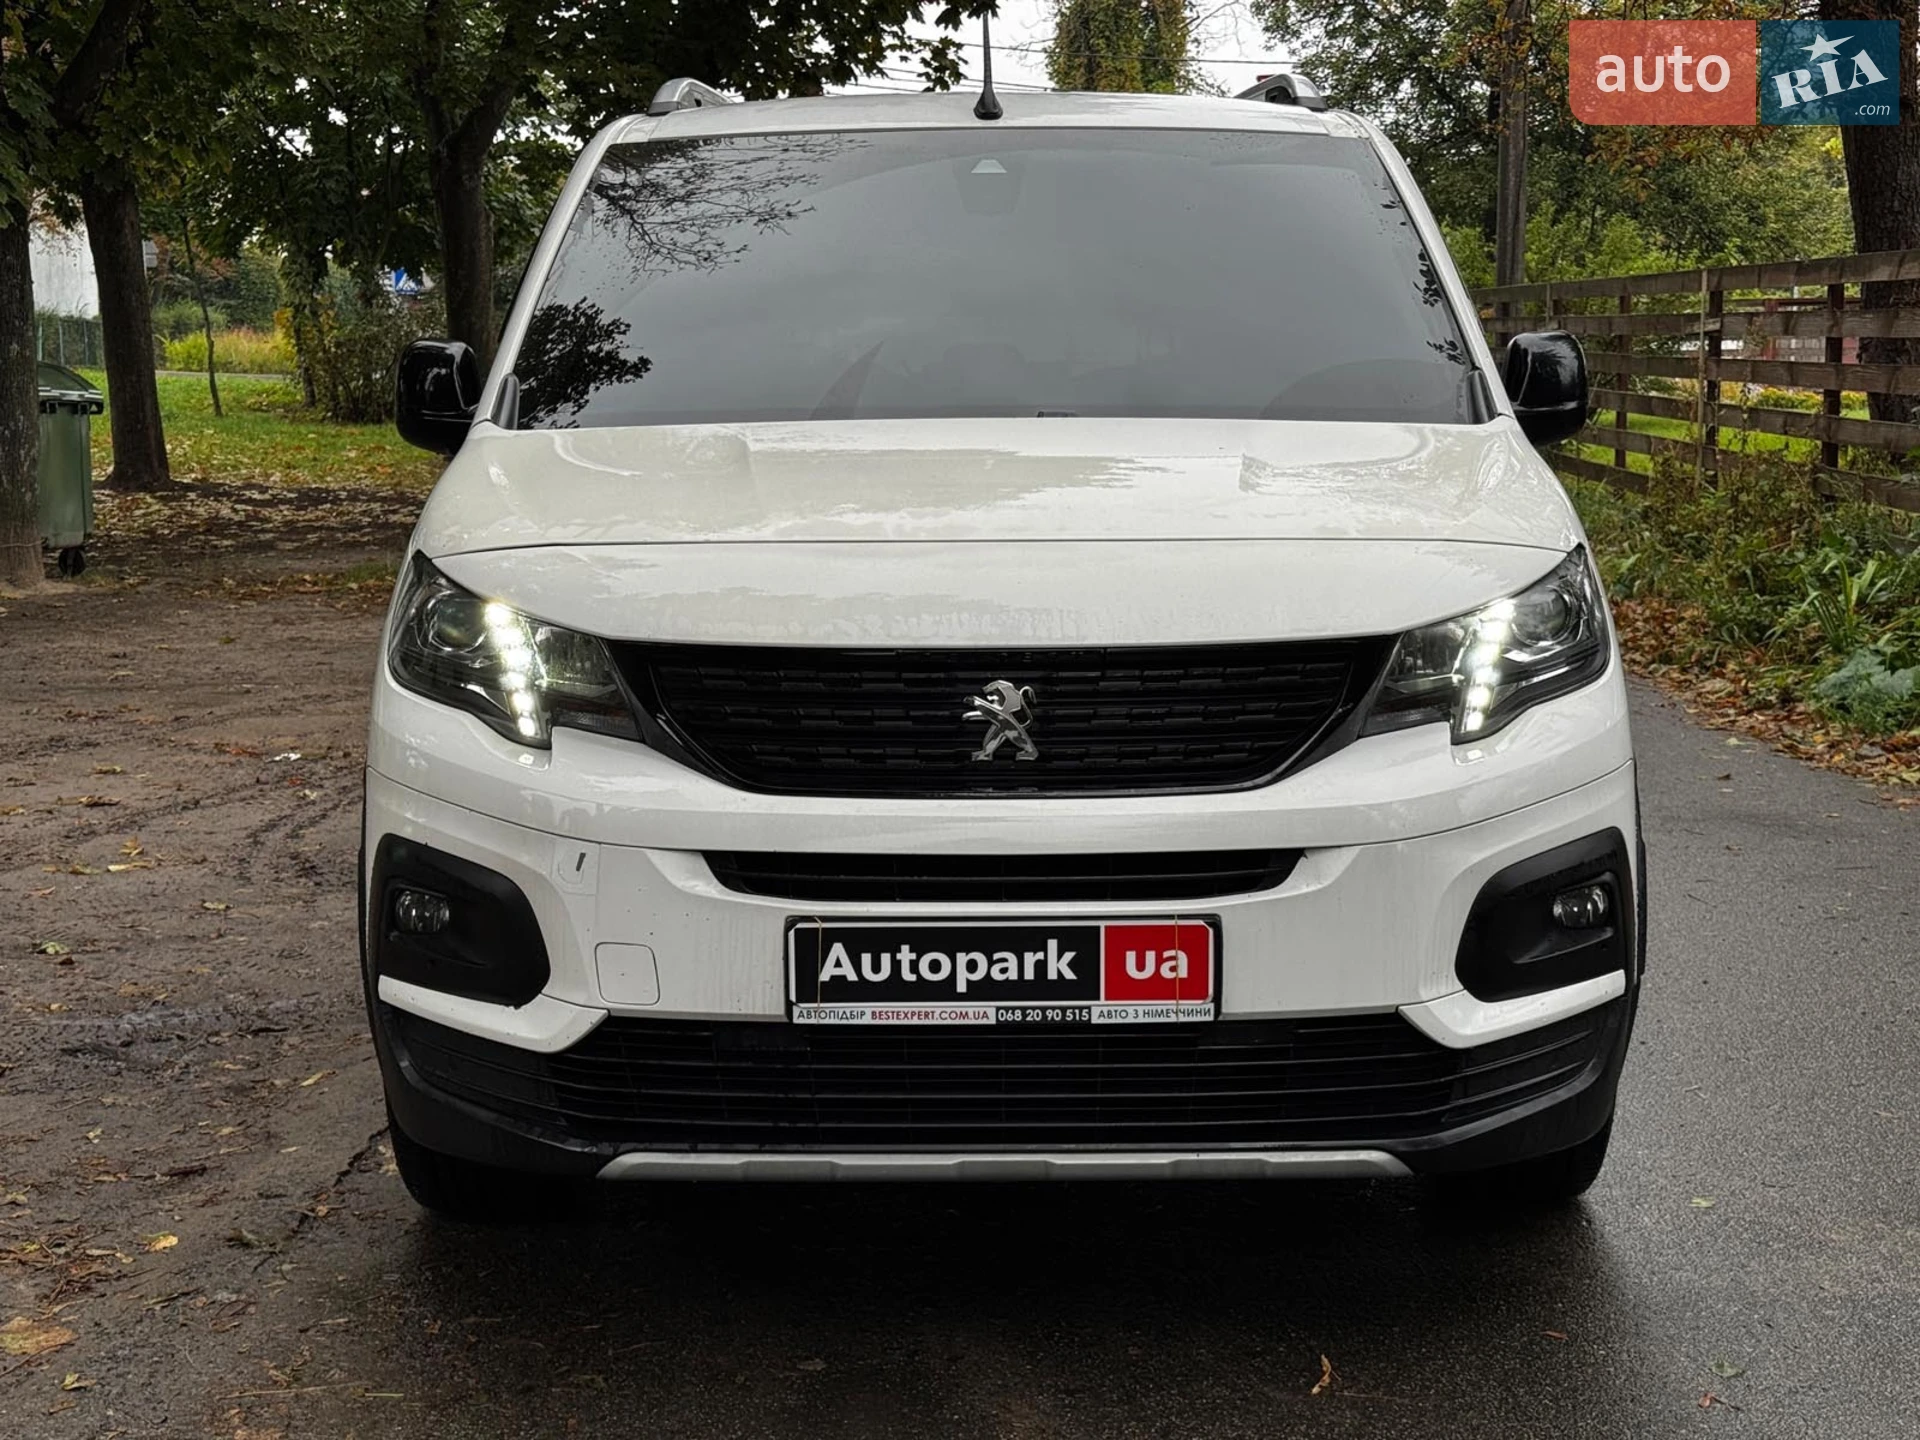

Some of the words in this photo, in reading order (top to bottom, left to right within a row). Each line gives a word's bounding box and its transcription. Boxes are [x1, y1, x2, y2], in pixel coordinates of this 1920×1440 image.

[819, 939, 1077, 993] Autopark
[1125, 948, 1189, 980] ua
[797, 1010, 866, 1021] АВТОПІДБІР
[871, 1010, 990, 1021] BESTEXPERT.COM.UA
[998, 1010, 1023, 1021] 068
[1026, 1010, 1042, 1021] 20
[1046, 1010, 1062, 1021] 90
[1065, 1010, 1090, 1021] 515
[1097, 1009, 1129, 1019] АВТО
[1142, 1007, 1212, 1019] НІМЕЧЧИНИ
